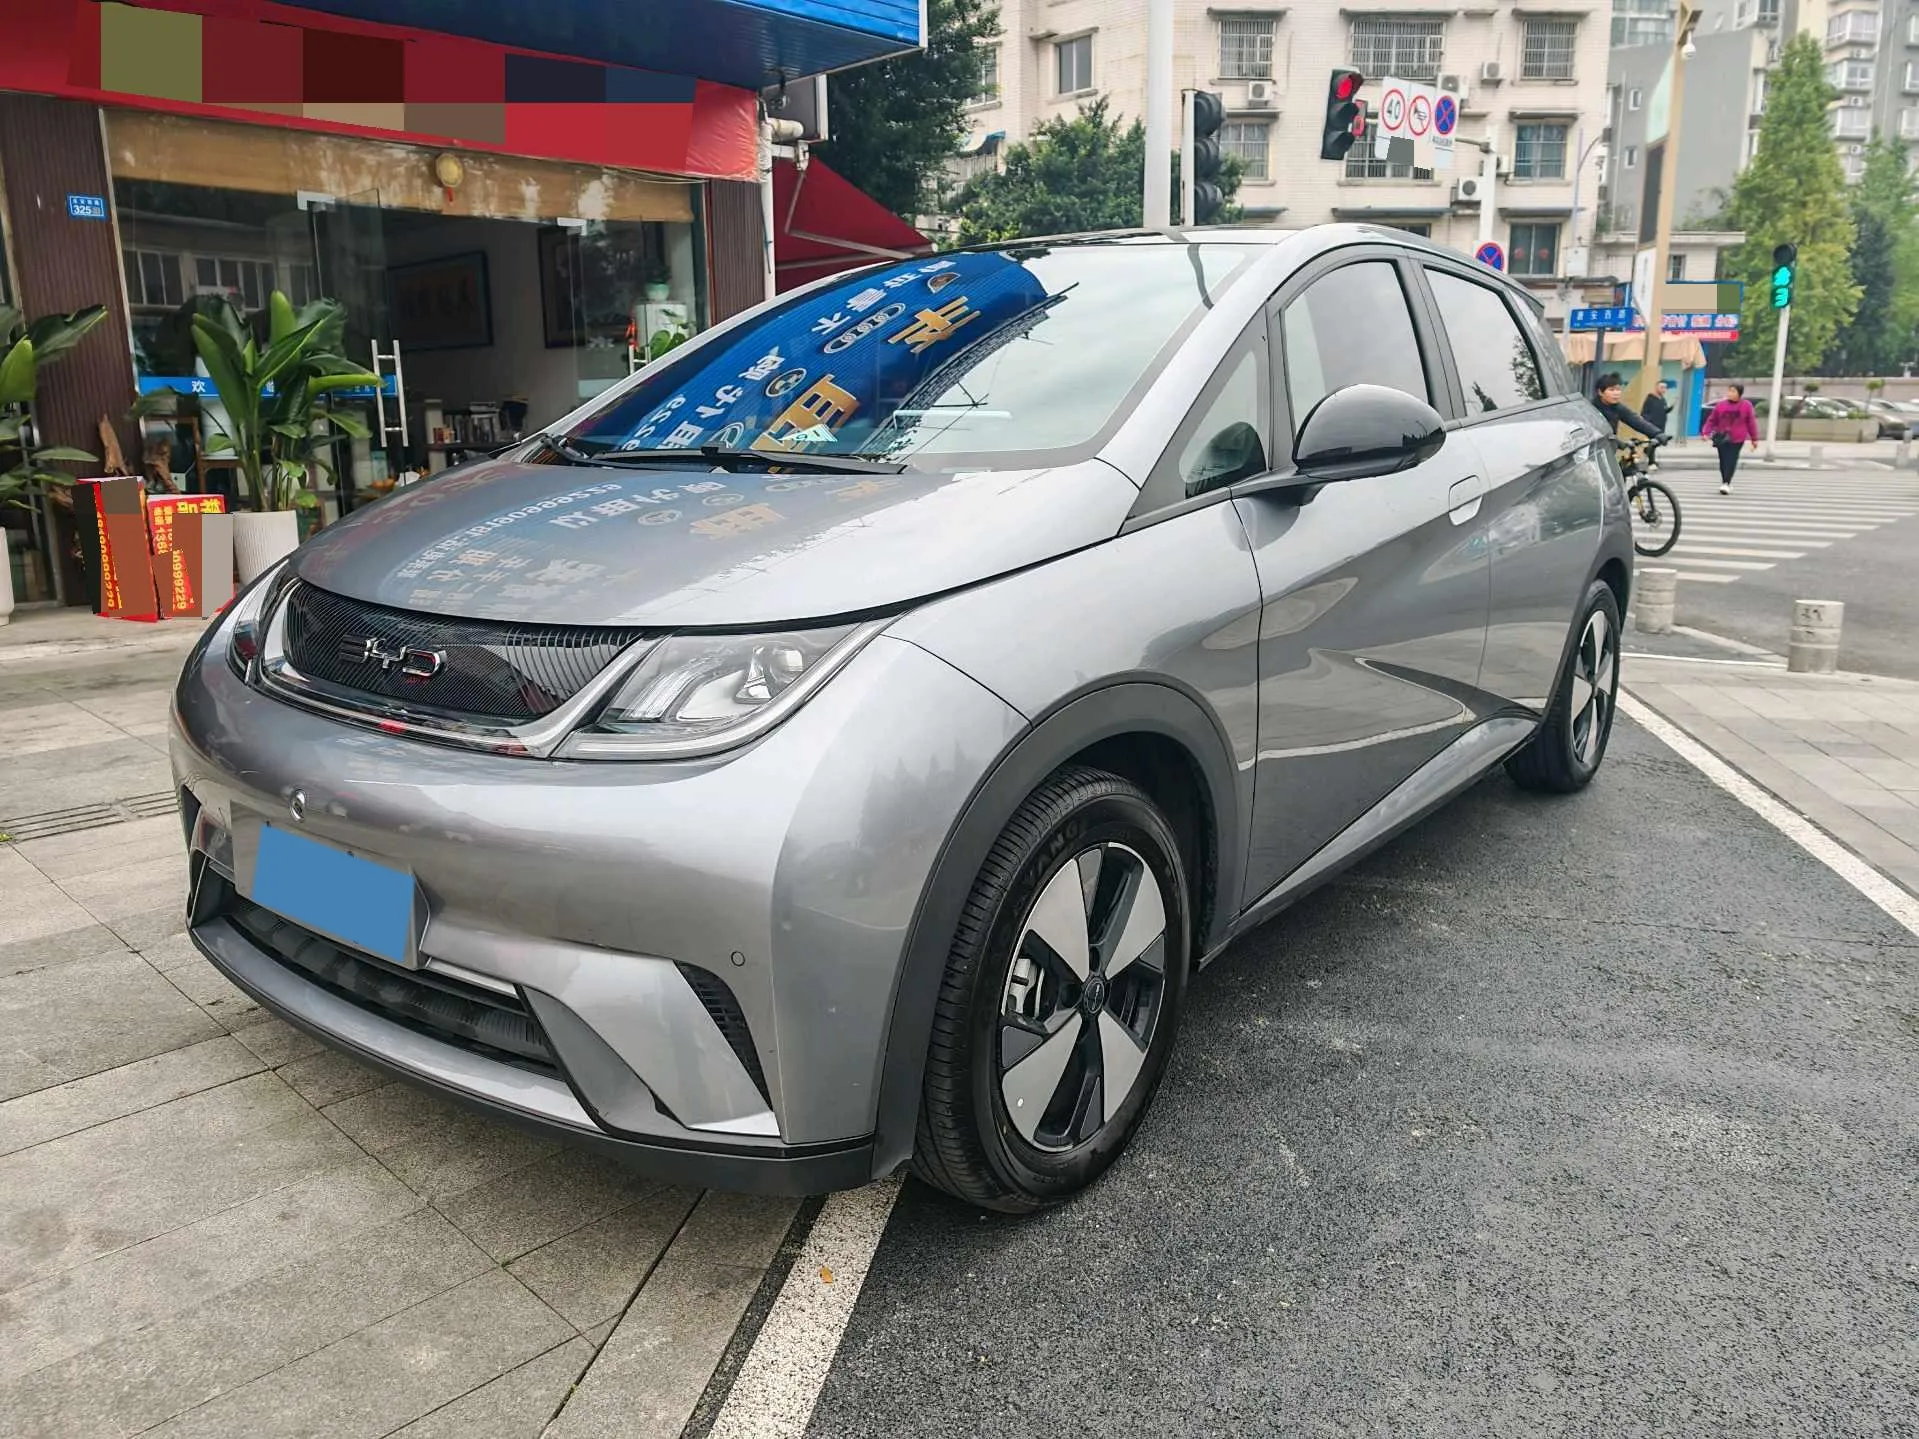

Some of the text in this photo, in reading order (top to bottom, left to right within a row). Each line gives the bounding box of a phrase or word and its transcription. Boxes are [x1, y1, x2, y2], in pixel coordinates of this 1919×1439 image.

[1386, 98, 1401, 120] 40
[73, 204, 92, 215] 325
[341, 634, 449, 677] BYD
